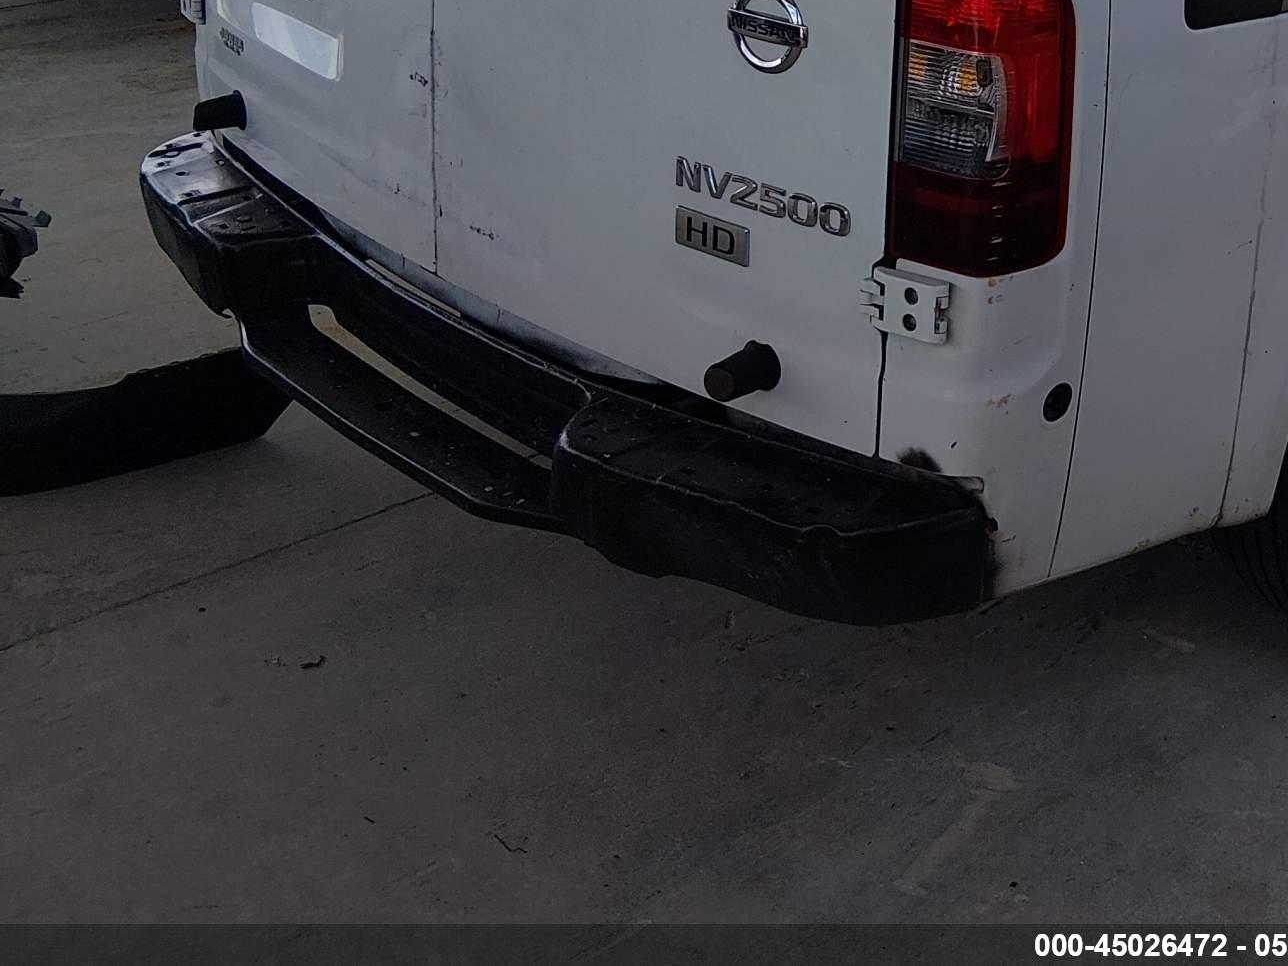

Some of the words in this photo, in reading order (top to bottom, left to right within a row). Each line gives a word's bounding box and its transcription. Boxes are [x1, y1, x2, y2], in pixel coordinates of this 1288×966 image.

[729, 14, 797, 42] NISSAN
[675, 155, 851, 237] NV2500
[686, 216, 735, 255] HD
